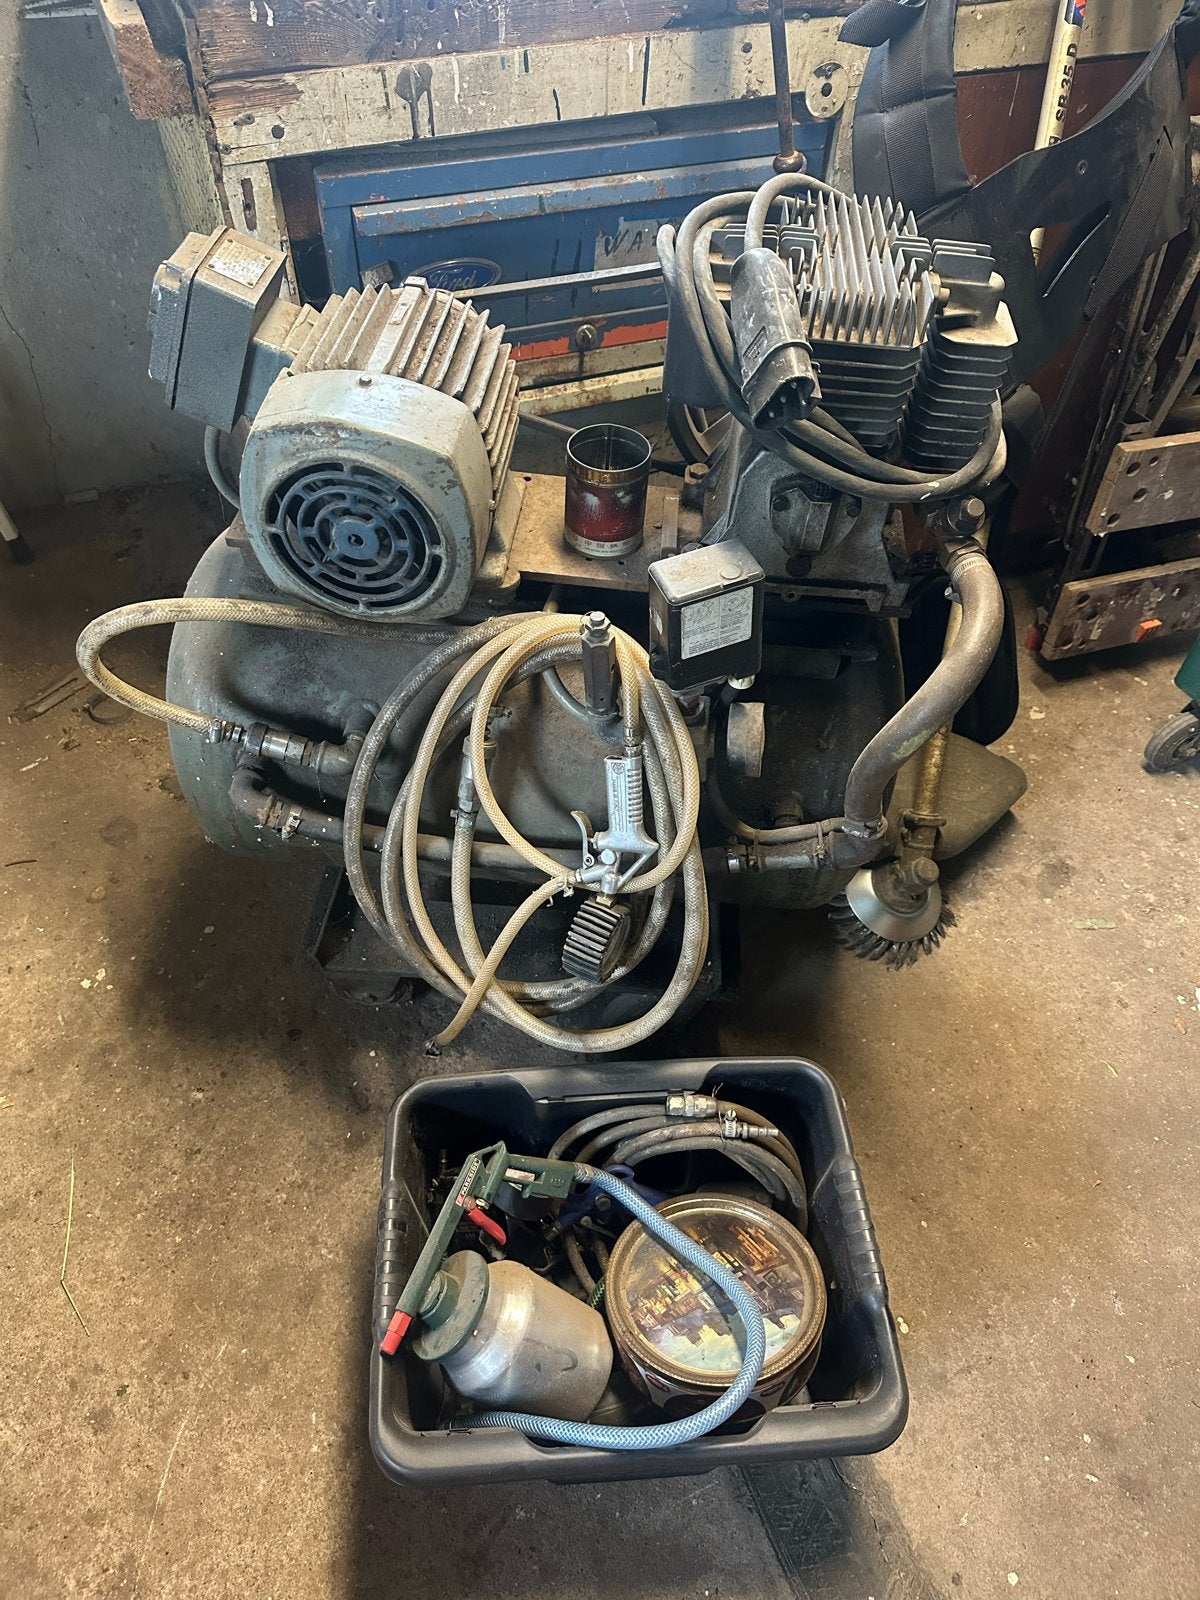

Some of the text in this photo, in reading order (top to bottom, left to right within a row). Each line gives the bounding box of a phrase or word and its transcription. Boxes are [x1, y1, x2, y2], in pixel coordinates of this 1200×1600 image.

[1067, 43, 1078, 57] D
[1061, 65, 1074, 91] 35
[430, 268, 477, 290] Ford
[462, 1160, 480, 1195] PARKSIDE
